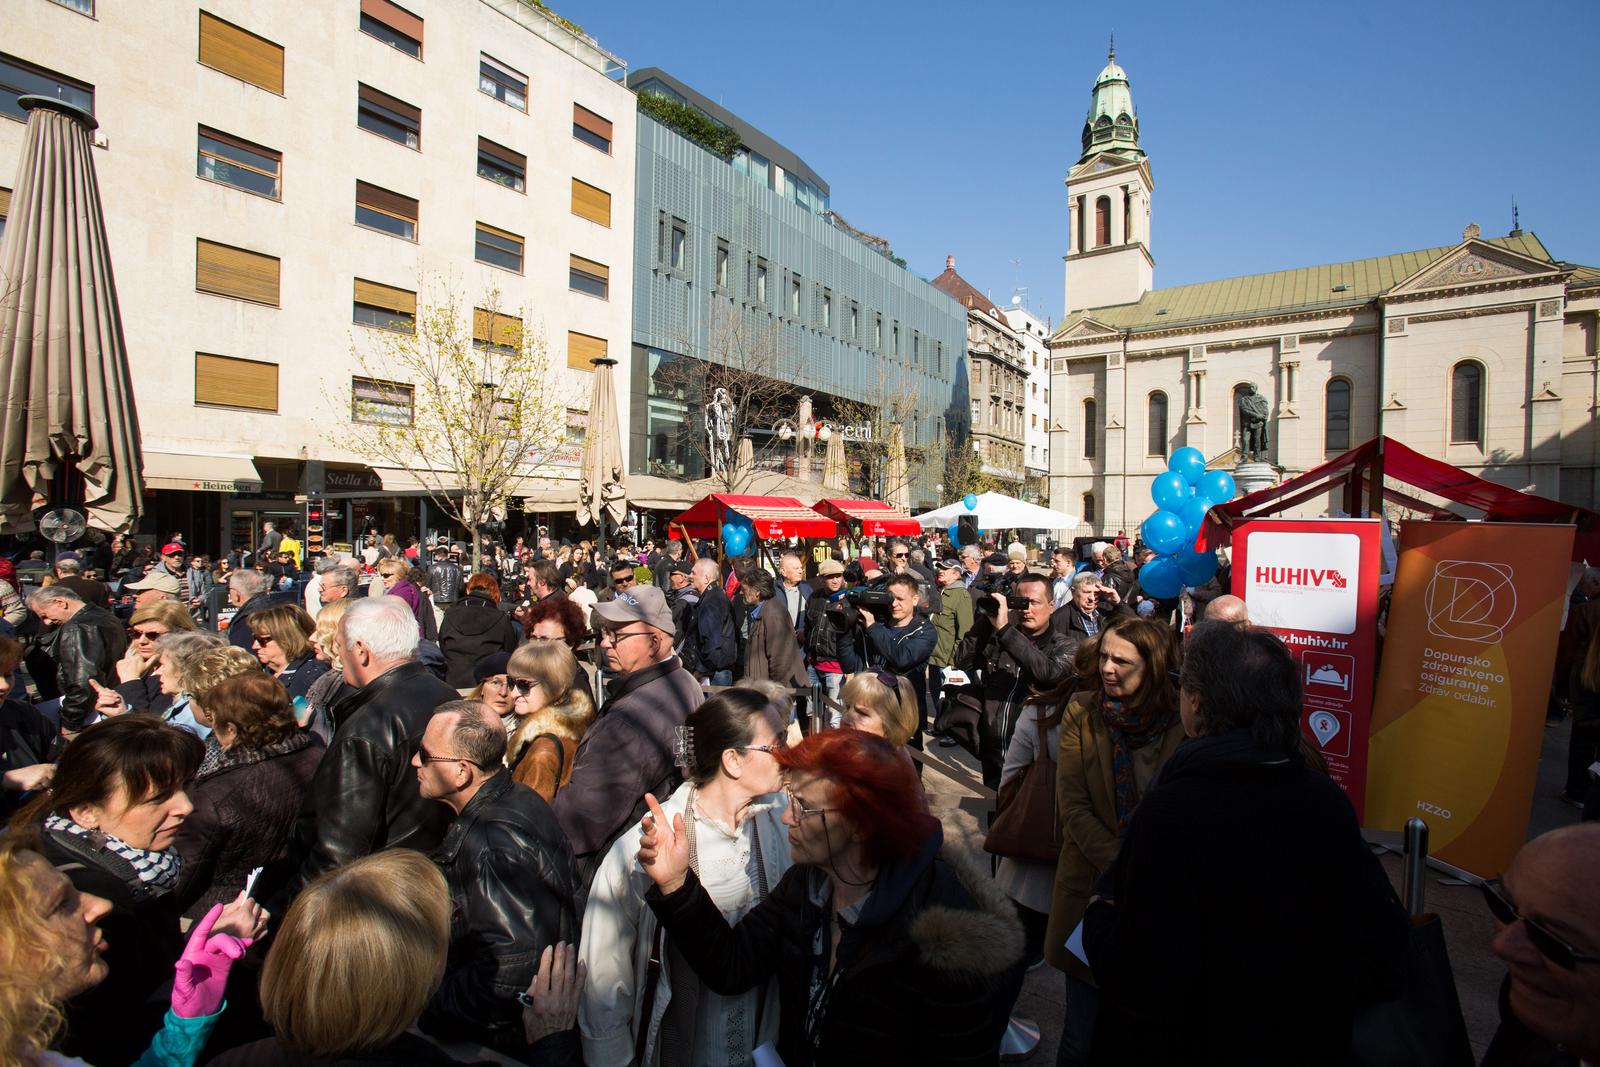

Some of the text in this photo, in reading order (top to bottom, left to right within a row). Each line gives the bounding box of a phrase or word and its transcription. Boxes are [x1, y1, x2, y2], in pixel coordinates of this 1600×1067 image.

[202, 482, 251, 491] Heineken
[326, 473, 360, 486] Stella
[1255, 566, 1326, 587] HUHIV
[1277, 633, 1349, 650] w.huhiv.hr
[1424, 647, 1492, 669] Dopunsko
[1422, 660, 1505, 683] zdravstveno
[1418, 682, 1451, 697] Zdrav
[1420, 672, 1489, 693] osiguranje
[1416, 800, 1452, 819] HZZO
